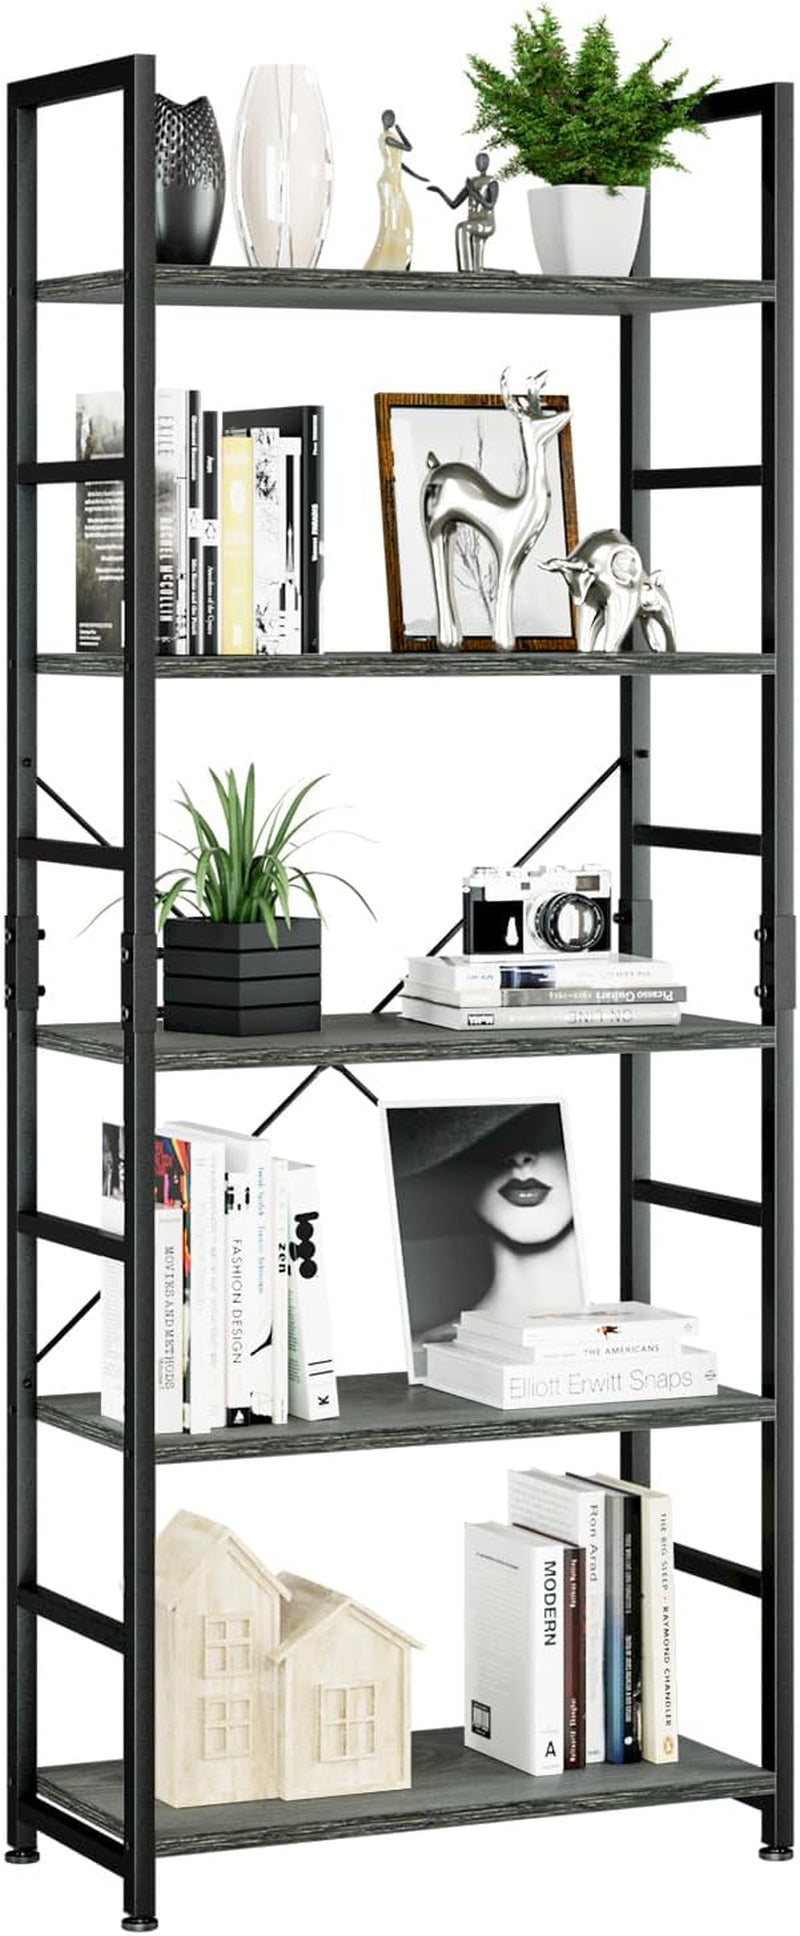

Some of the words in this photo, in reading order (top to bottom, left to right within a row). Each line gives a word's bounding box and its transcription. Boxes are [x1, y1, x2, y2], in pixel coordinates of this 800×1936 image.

[157, 415, 176, 456] EXILE
[158, 516, 175, 560] RACHEL
[636, 989, 674, 1002] Picasso
[278, 1242, 287, 1274] zen
[288, 1211, 319, 1279] logo
[164, 1246, 176, 1298] MOVIES
[231, 1238, 243, 1304] FASHION
[164, 1300, 176, 1328] AND
[231, 1310, 243, 1364] DESIGN
[583, 1348, 600, 1356] THE
[605, 1344, 660, 1355] AMERICANS
[164, 1328, 176, 1390] METHODS
[509, 1376, 561, 1399] Elliott
[568, 1372, 622, 1395] Erwitt
[630, 1368, 693, 1393] Snaps
[589, 1504, 599, 1537] Ron
[660, 1512, 668, 1534] THE
[589, 1544, 599, 1582] Arad
[660, 1536, 668, 1556] BIG
[660, 1560, 669, 1592] SLEEP
[544, 1560, 557, 1646] MODERN
[662, 1606, 671, 1664] RAYMOND
[663, 1668, 673, 1727] CHANDLER
[545, 1741, 557, 1757] A
